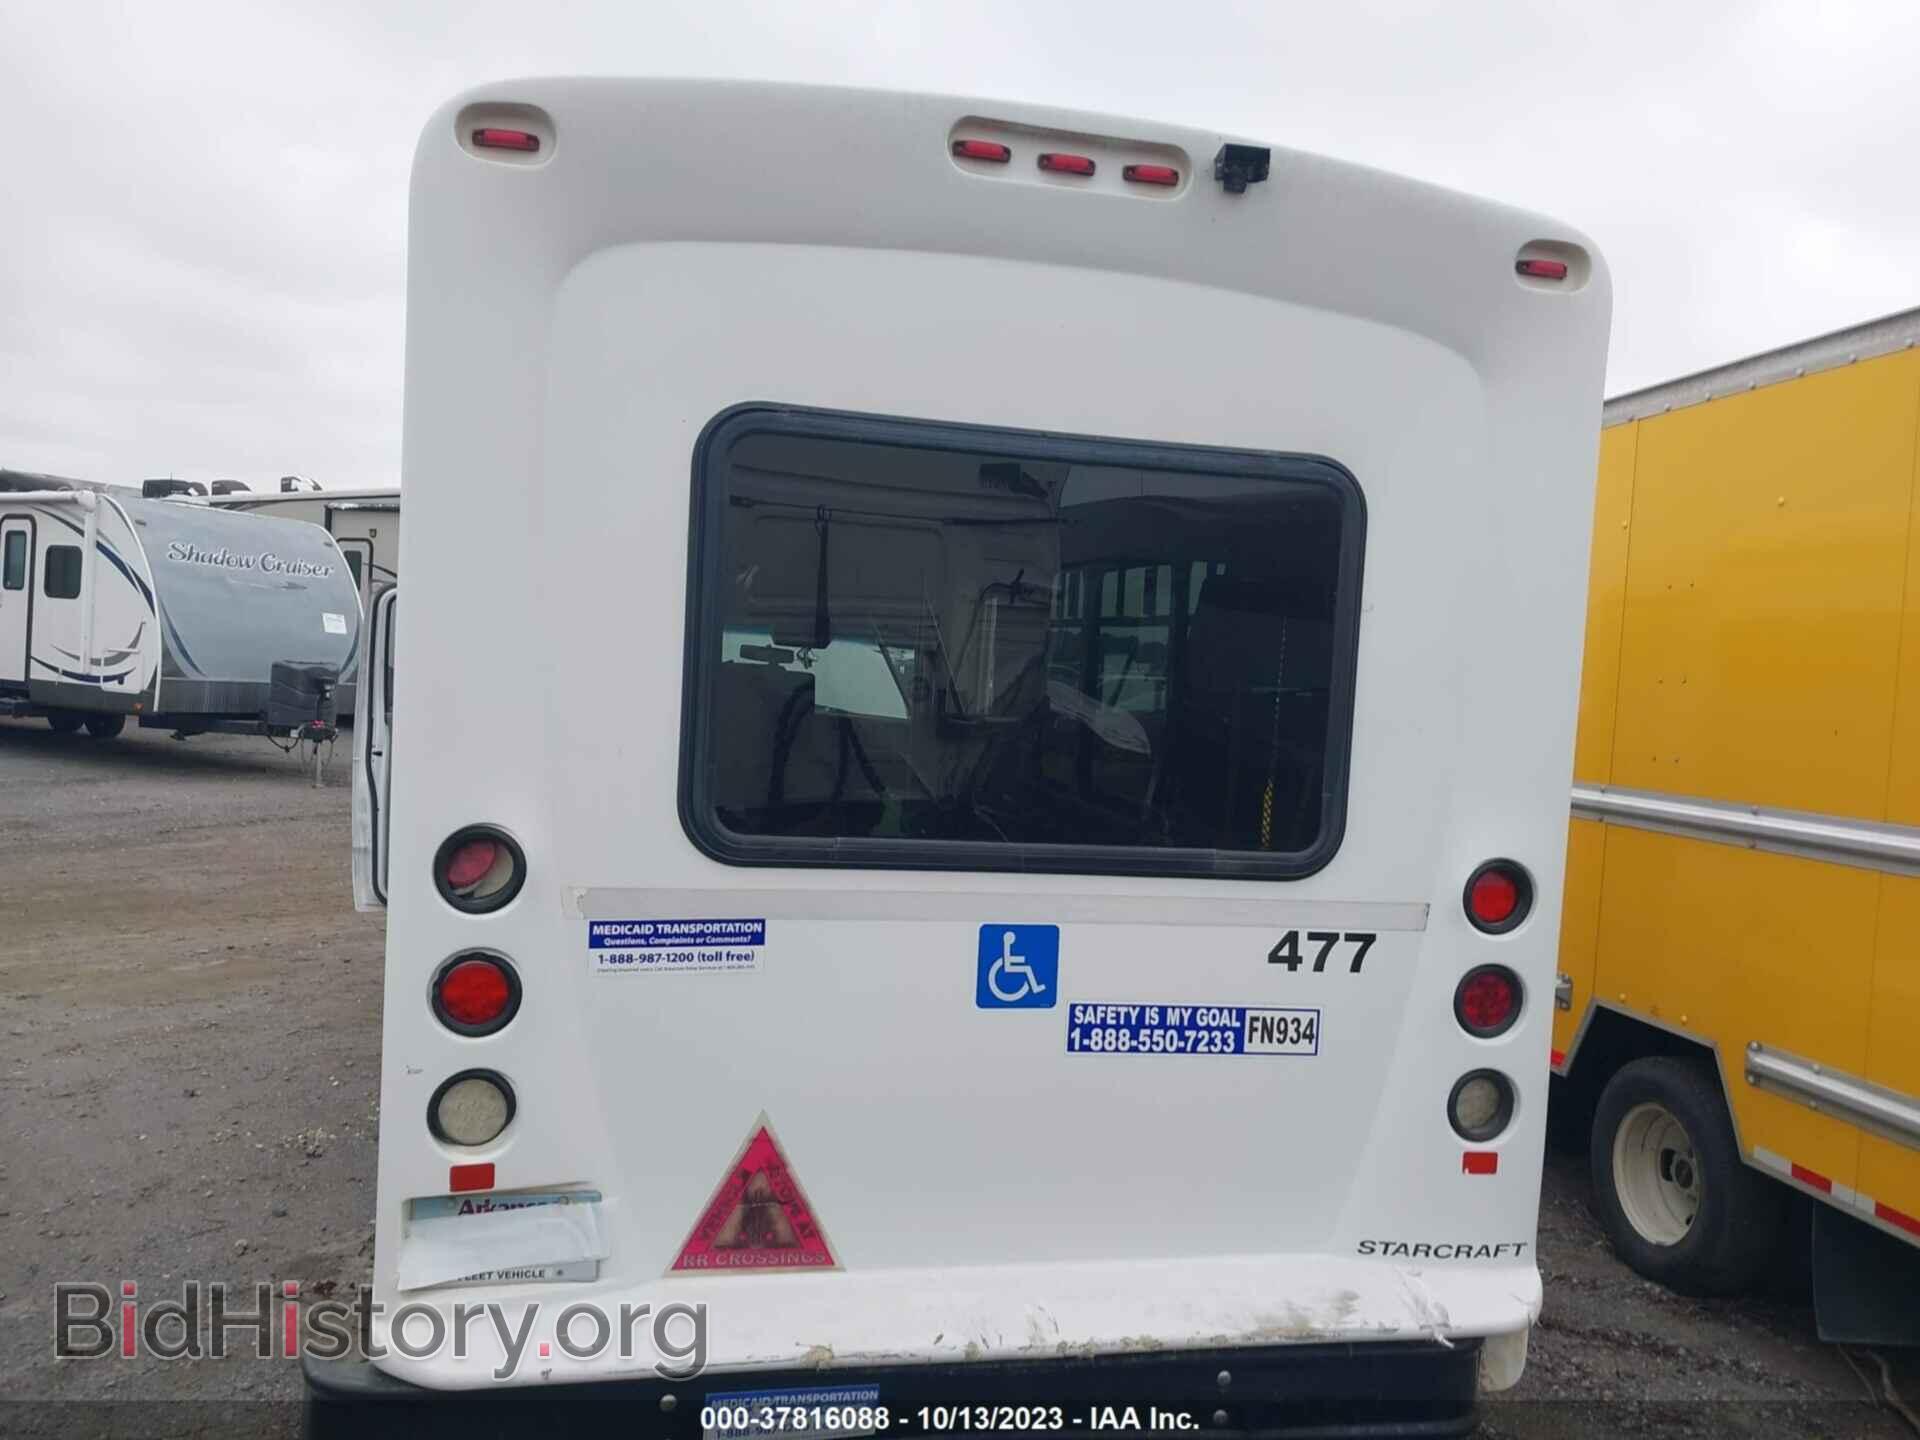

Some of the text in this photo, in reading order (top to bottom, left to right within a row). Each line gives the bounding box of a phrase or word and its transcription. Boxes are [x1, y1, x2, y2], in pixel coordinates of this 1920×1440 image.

[167, 541, 334, 577] Shadow Cruiser
[592, 922, 763, 936] MEDICAID TRANSPORTATION
[649, 935, 694, 945] Complaints
[706, 935, 751, 943] Comments?
[597, 950, 755, 964] 1-888-987-1200 (toll free)
[1267, 930, 1377, 973] 477
[1074, 1006, 1241, 1027] SAFETY IS MY GOAL
[1248, 1016, 1315, 1045] FN934
[1070, 1028, 1235, 1053] 1-888-550-7233
[1357, 1240, 1528, 1259] STARCRAFT
[683, 1252, 826, 1267] RR CROSSINGS
[458, 1269, 545, 1281] LEET VEHICLE
[772, 1389, 878, 1407] TRANSPORTATION
